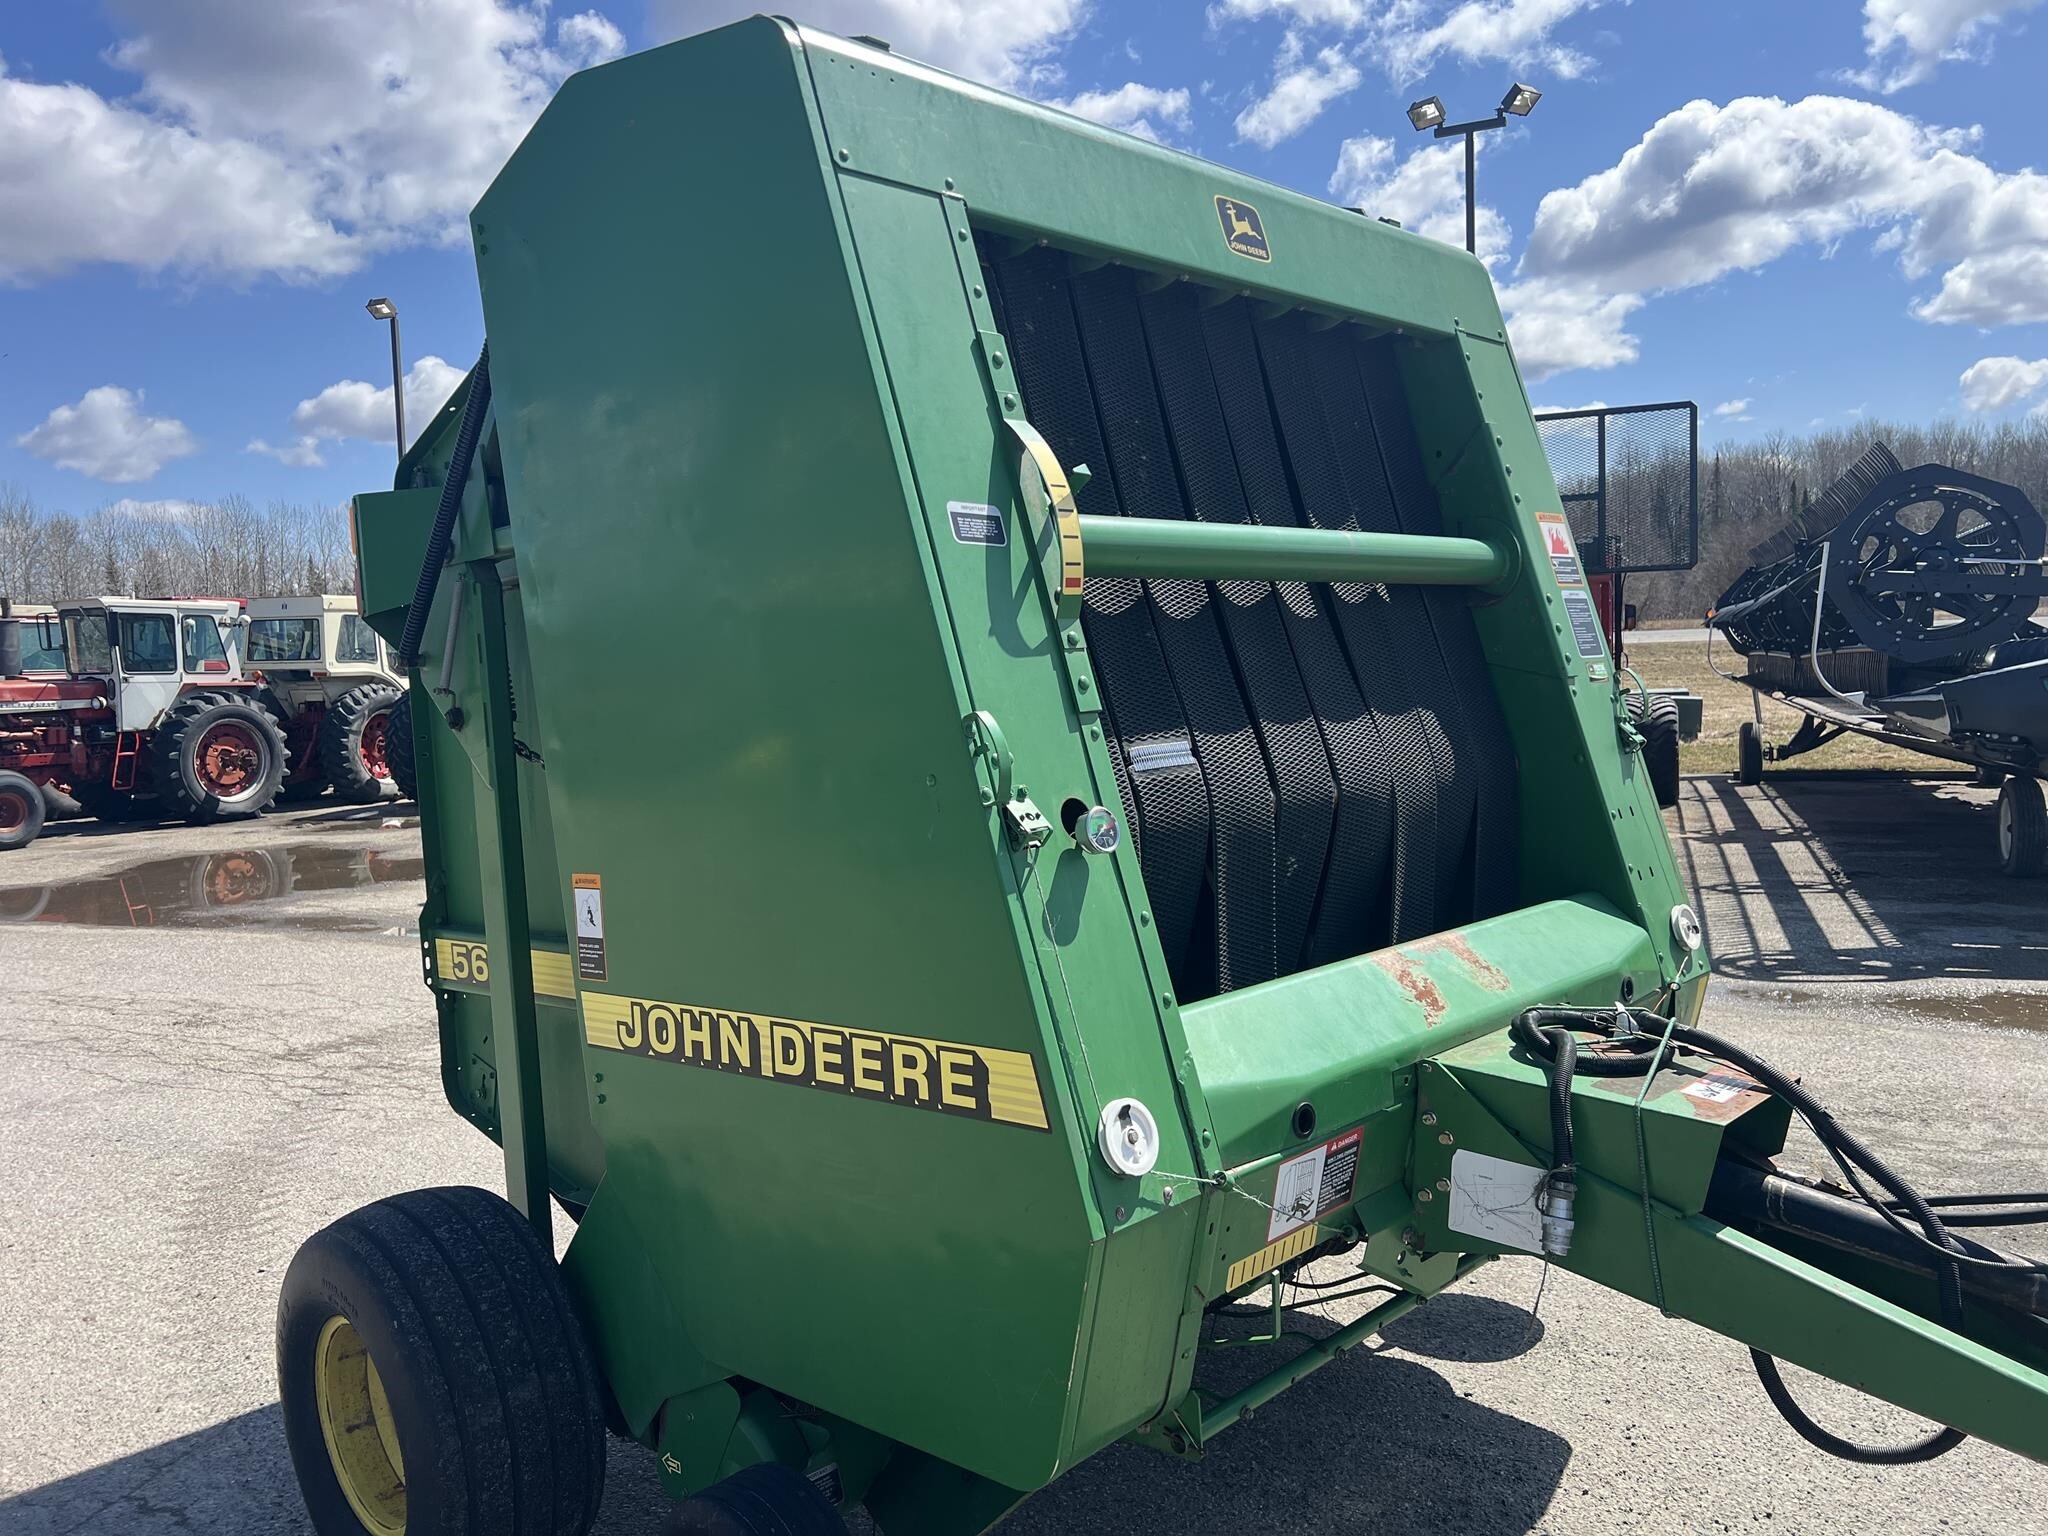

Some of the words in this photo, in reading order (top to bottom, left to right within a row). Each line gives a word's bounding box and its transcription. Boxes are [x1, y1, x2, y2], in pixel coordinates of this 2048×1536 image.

[1230, 241, 1248, 252] JOHN
[1247, 245, 1268, 258] DEERE
[617, 1001, 756, 1068] JOHN
[770, 1020, 984, 1111] DEERE
